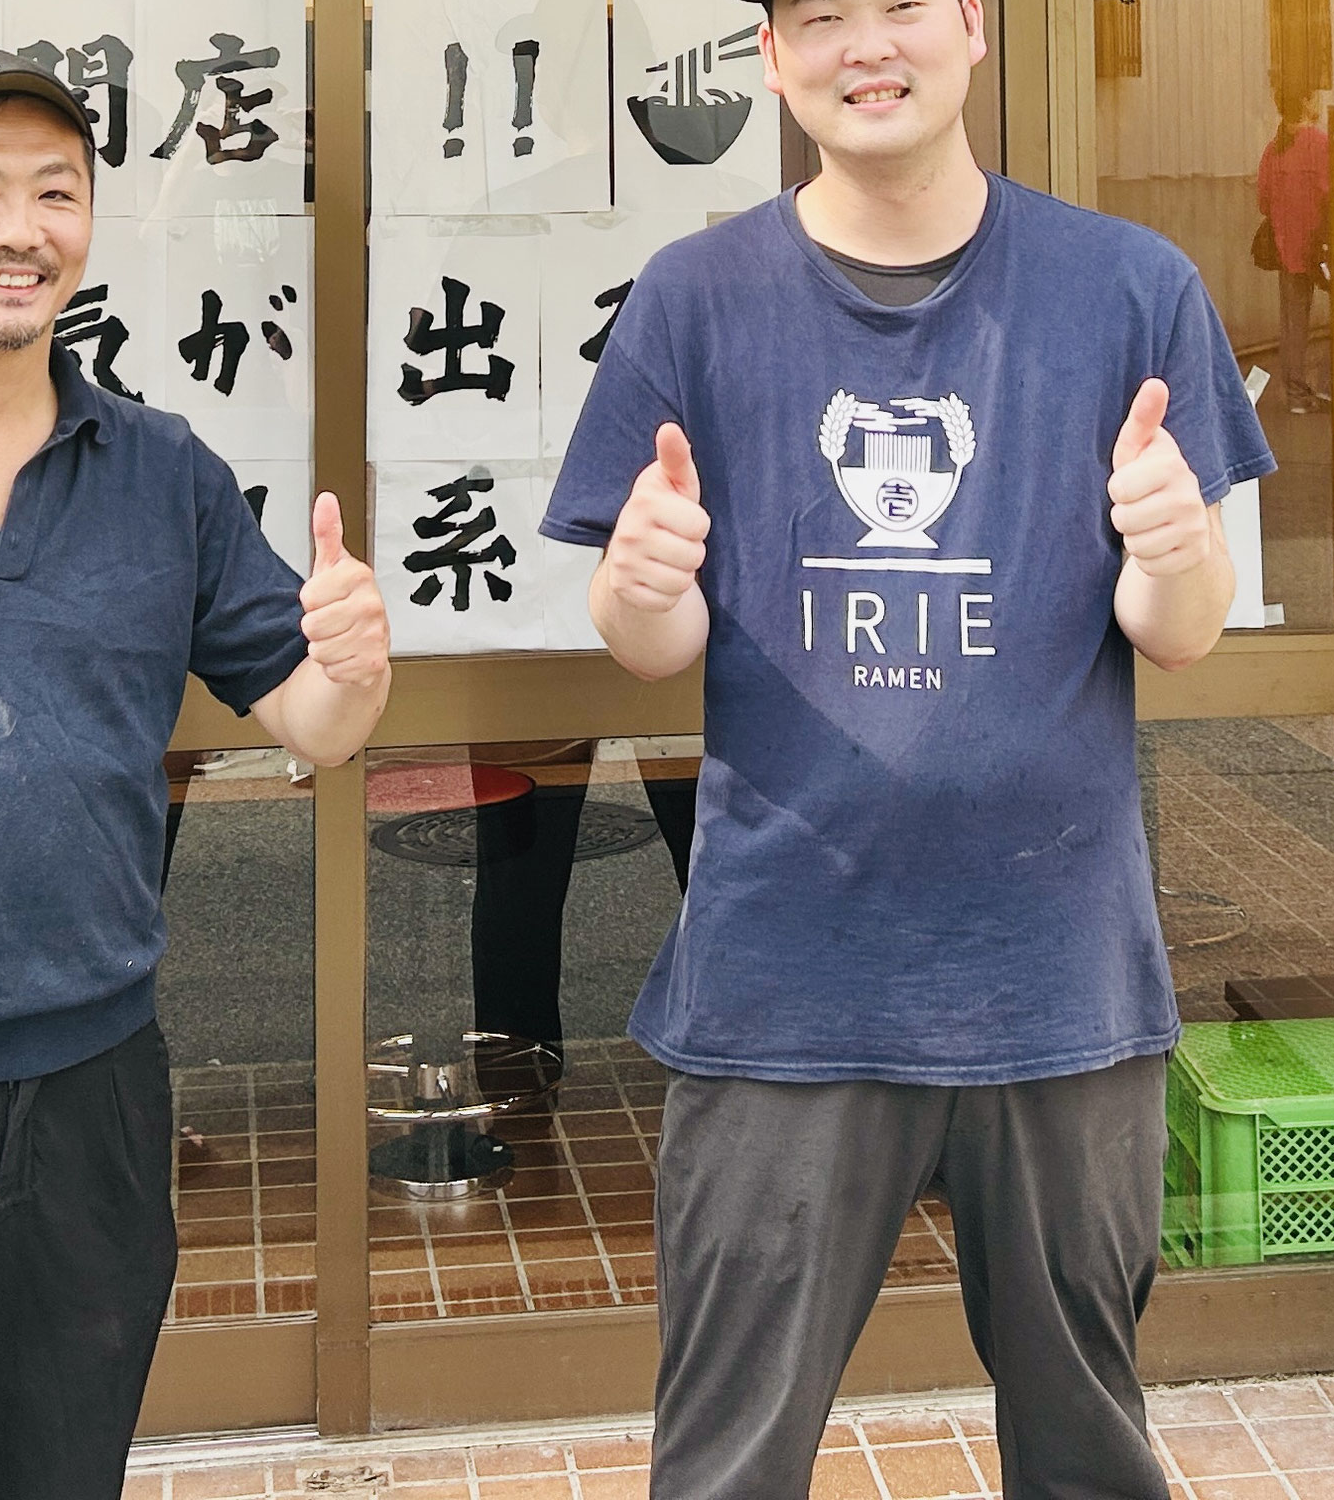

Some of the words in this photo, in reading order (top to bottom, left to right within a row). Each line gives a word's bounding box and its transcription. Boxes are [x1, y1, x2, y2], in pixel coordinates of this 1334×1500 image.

[403, 476, 517, 612] 系
[801, 589, 997, 657] IRIE
[852, 664, 944, 691] RAMEN
